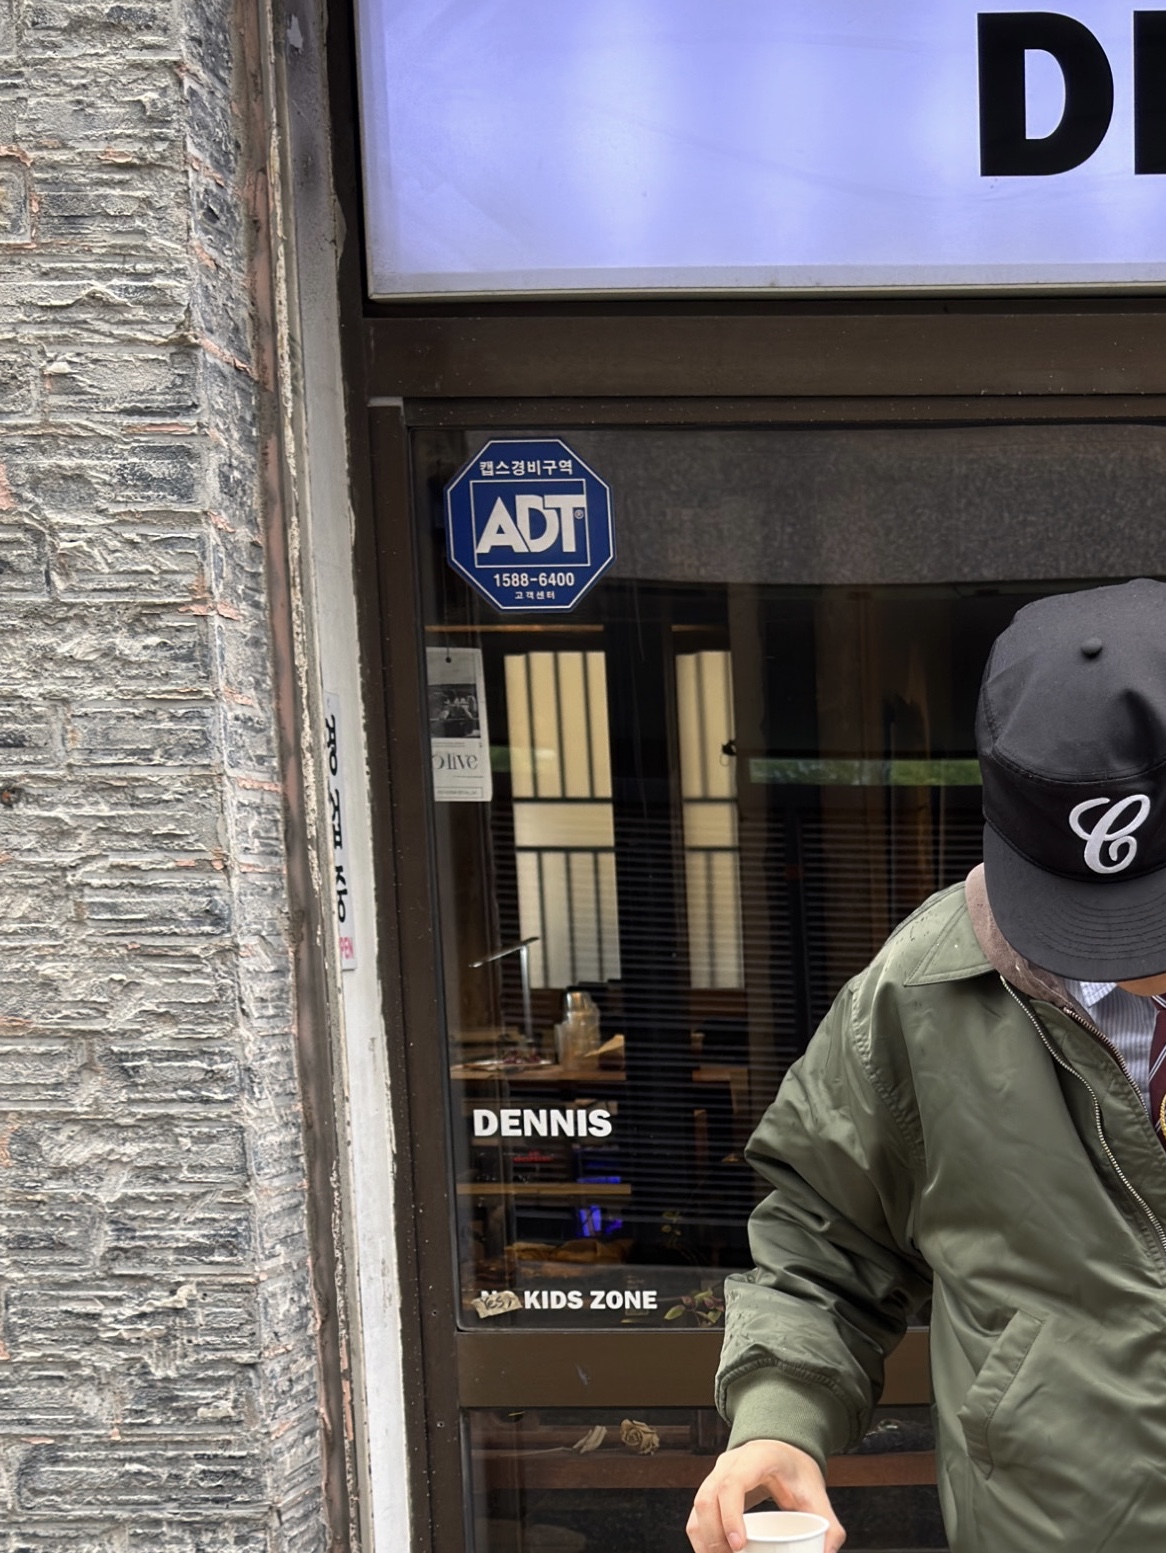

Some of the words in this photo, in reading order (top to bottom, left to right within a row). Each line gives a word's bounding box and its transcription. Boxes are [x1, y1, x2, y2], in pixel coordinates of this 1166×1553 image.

[479, 460, 573, 476] 캡스경비구역
[476, 495, 586, 553] ADT
[494, 572, 575, 587] 1588-6400
[514, 591, 556, 600] 고객센터
[339, 936, 354, 959] PEN
[473, 1109, 612, 1137] DENNIS
[524, 1290, 583, 1309] KIDS
[590, 1290, 658, 1309] ZONE
